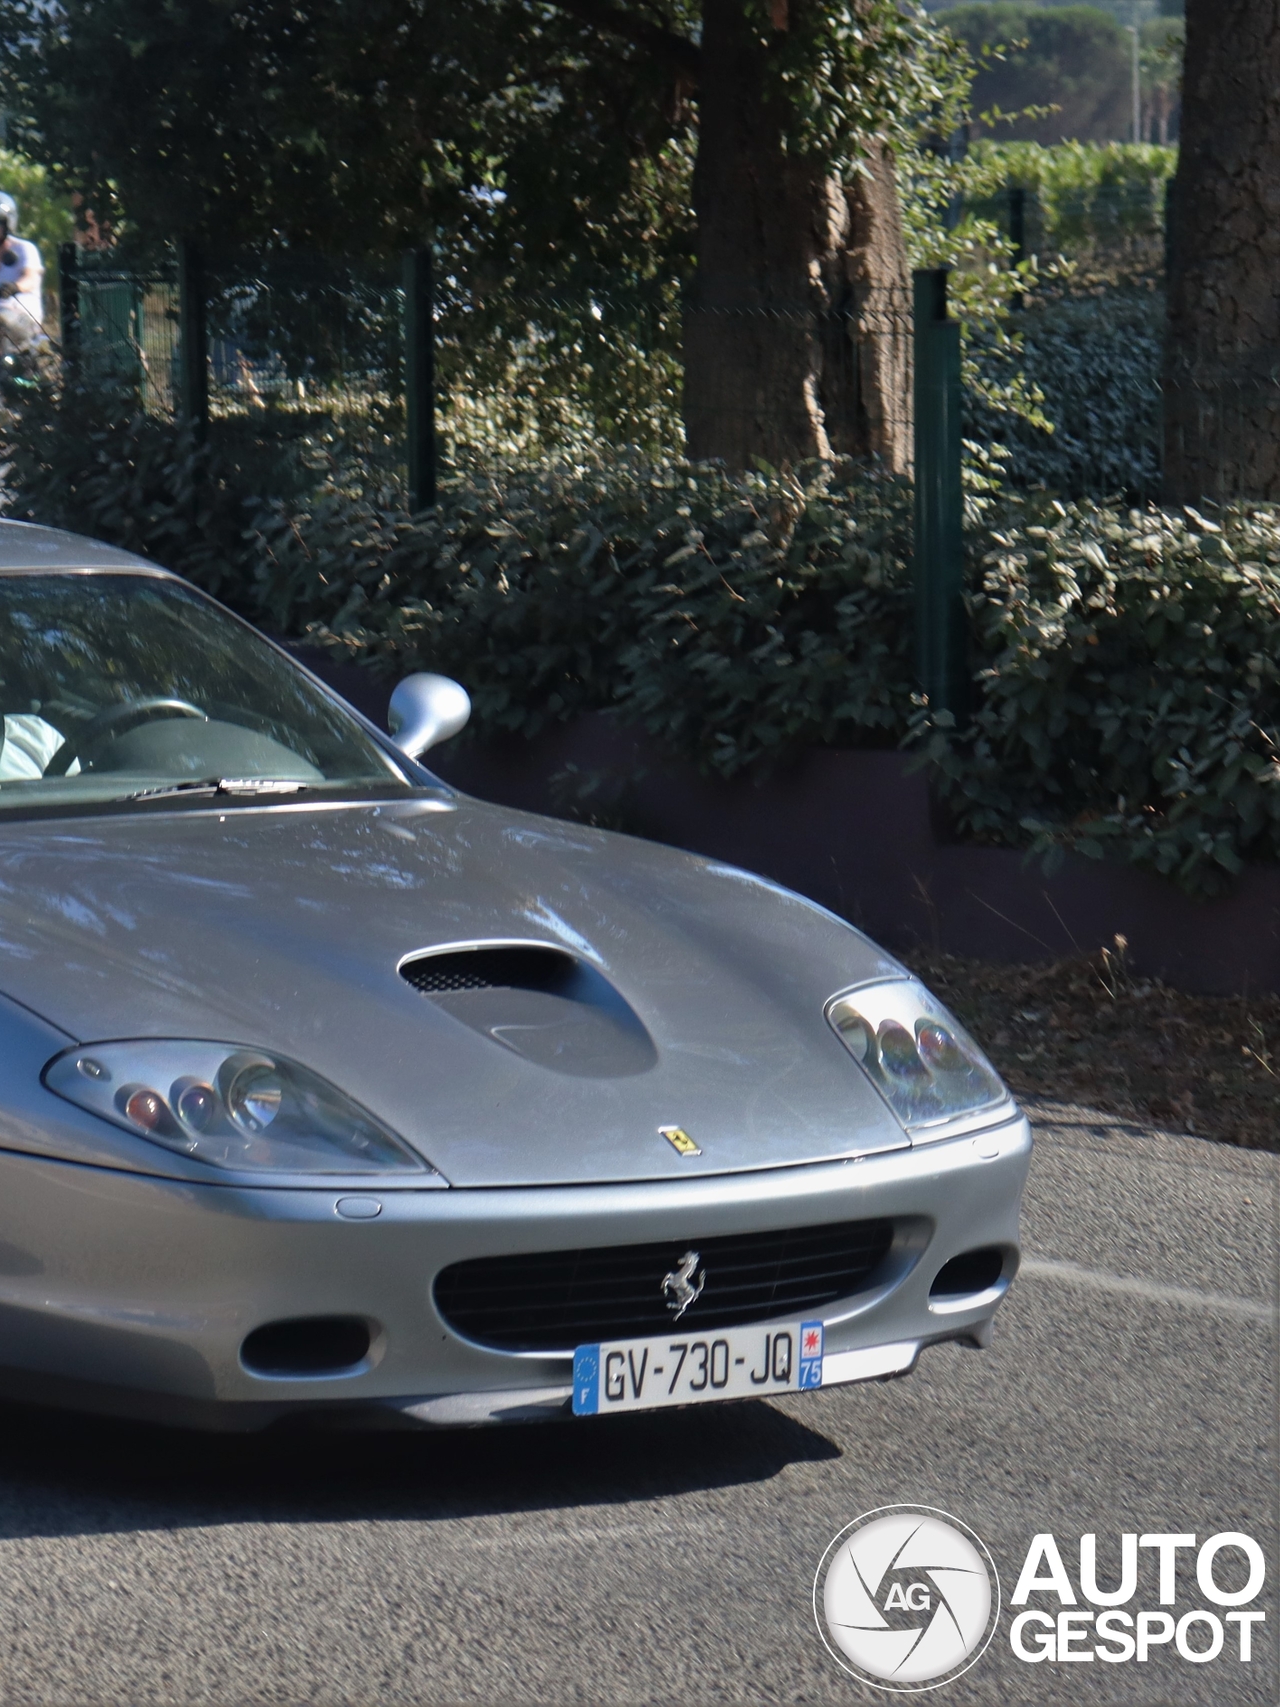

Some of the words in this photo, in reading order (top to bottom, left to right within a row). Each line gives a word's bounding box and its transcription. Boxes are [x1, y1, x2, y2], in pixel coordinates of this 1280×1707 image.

[604, 1332, 793, 1403] GV-730-JQ
[800, 1360, 821, 1385] 75
[580, 1387, 591, 1404] F
